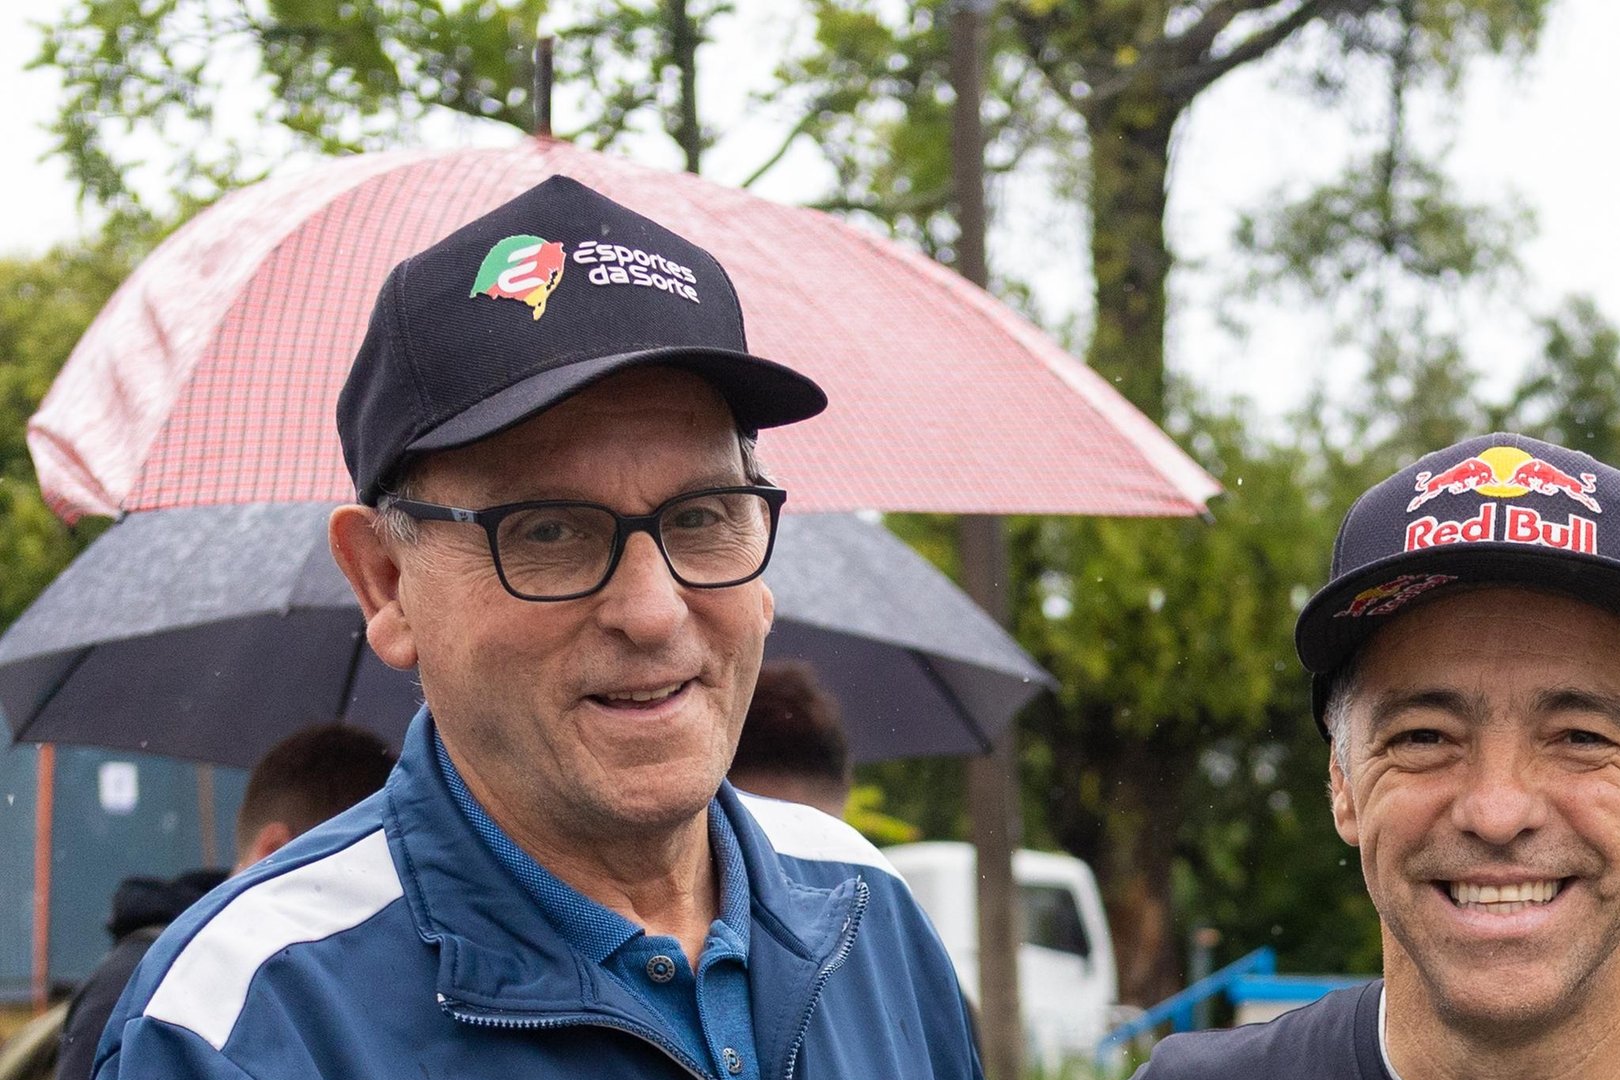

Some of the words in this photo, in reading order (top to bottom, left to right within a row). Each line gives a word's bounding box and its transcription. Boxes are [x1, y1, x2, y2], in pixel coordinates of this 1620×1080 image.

[573, 241, 698, 284] Esportes
[1405, 503, 1496, 551] Red
[1506, 505, 1597, 555] Bull
